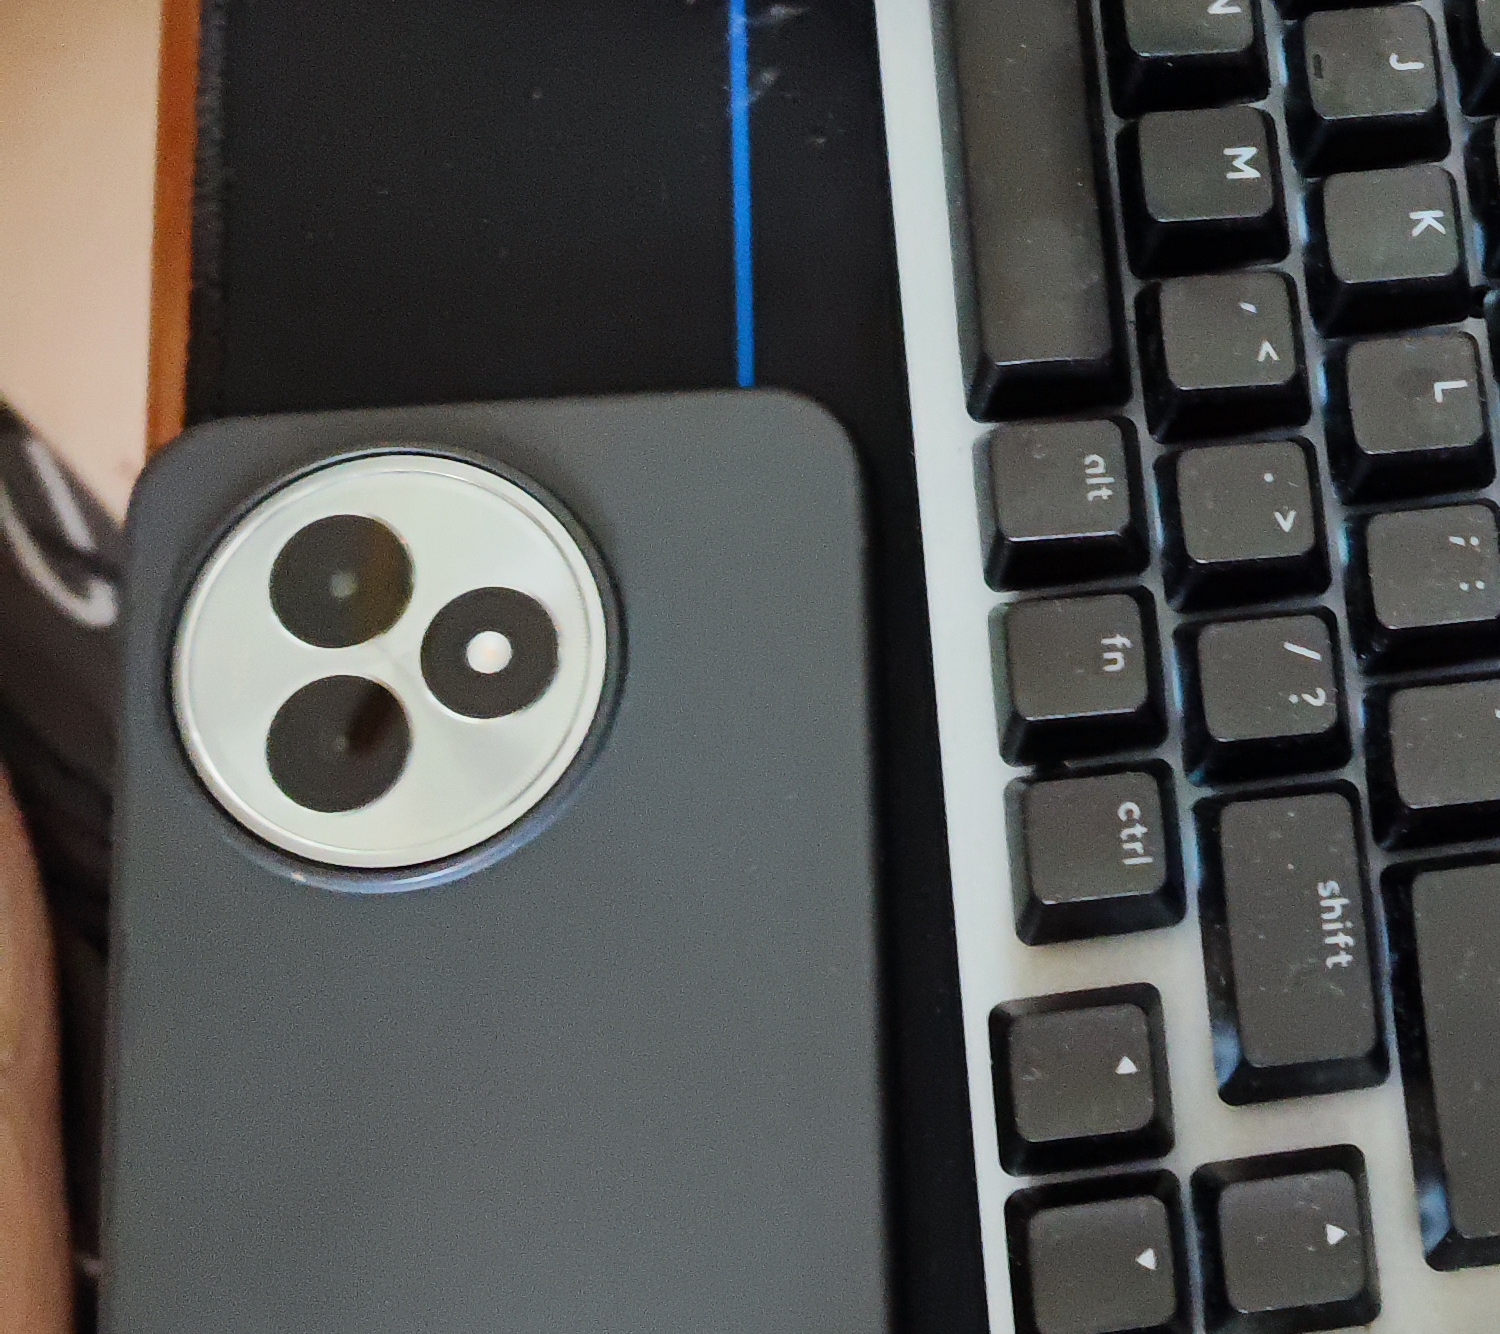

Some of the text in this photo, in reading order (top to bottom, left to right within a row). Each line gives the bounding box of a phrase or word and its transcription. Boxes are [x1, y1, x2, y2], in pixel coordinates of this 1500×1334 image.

[1389, 53, 1425, 71] J
[1223, 146, 1261, 180] M
[1409, 209, 1446, 237] K
[1433, 379, 1468, 403] L
[1084, 454, 1115, 502] alt
[1101, 634, 1132, 672] fn
[1117, 801, 1154, 866] ctrl
[1317, 880, 1355, 969] shift
